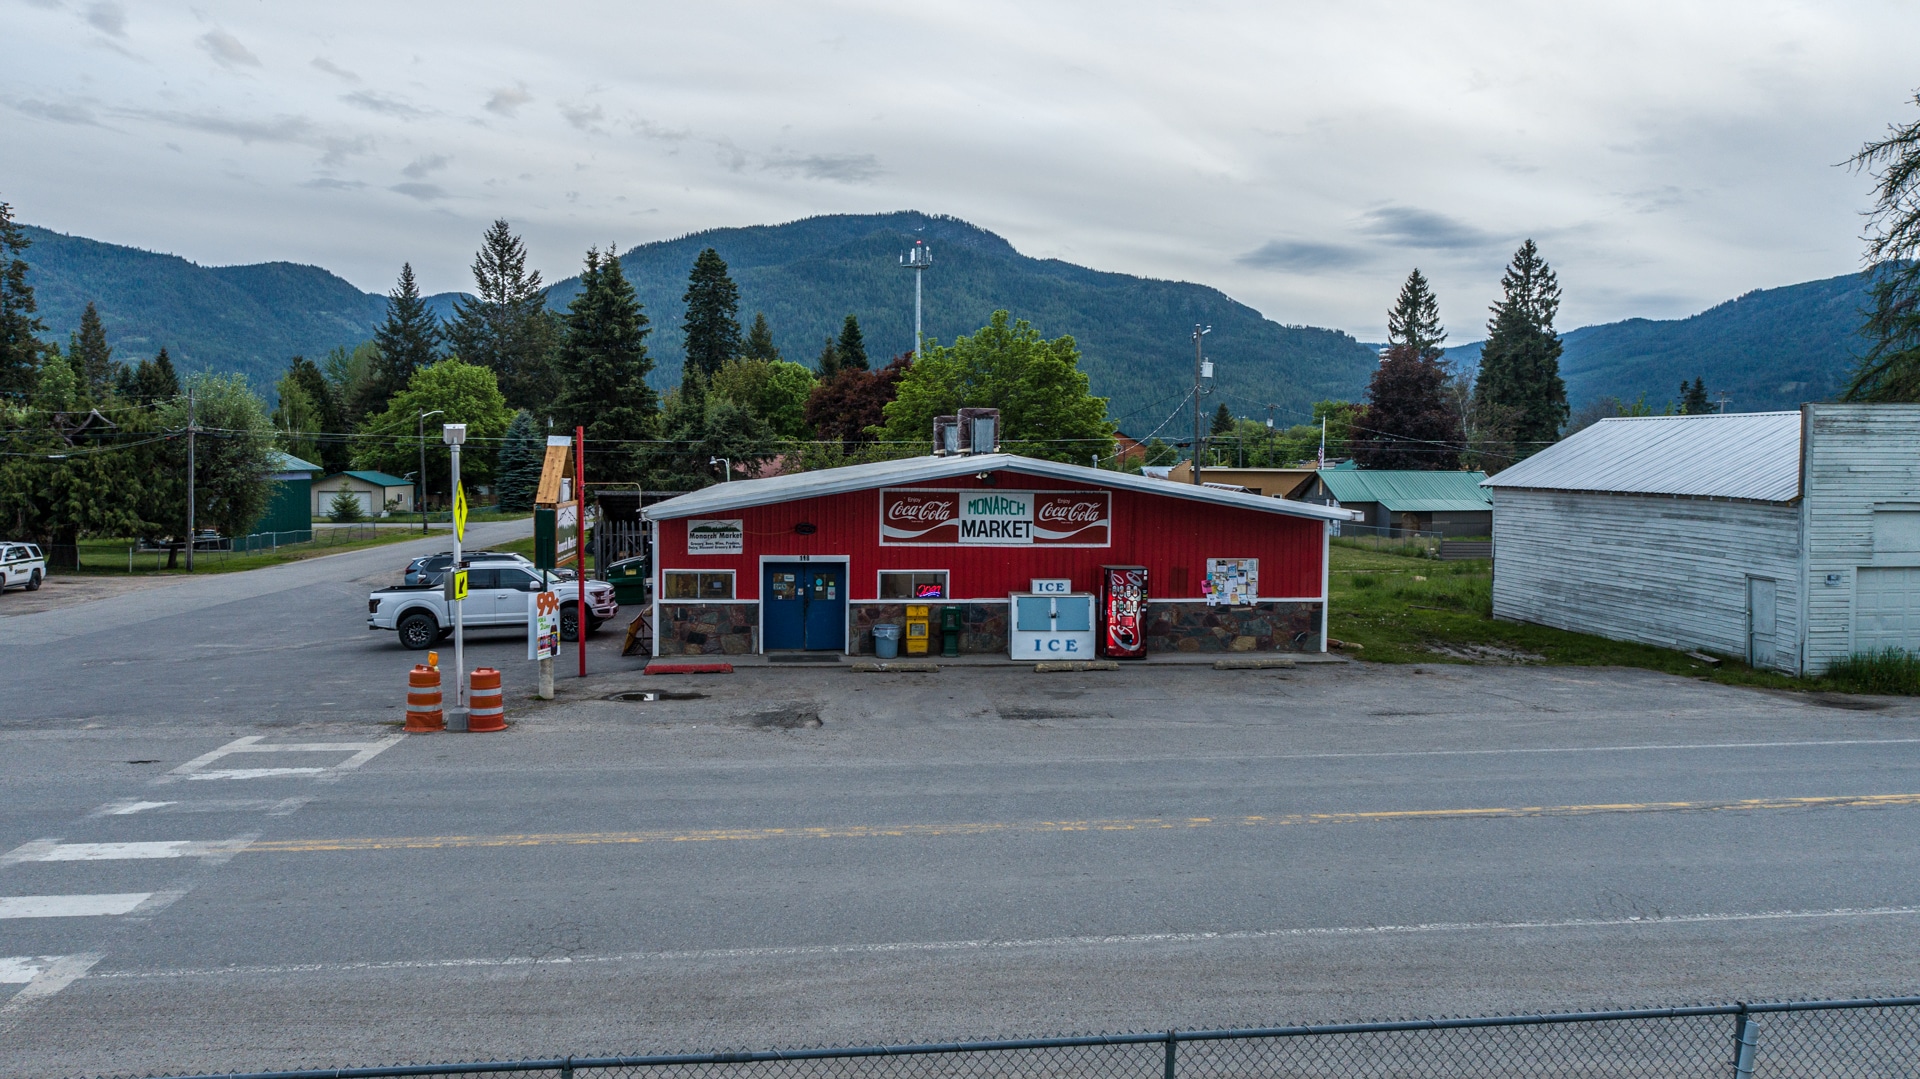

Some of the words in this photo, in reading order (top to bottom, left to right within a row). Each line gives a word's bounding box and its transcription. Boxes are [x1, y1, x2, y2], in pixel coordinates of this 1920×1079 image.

[907, 496, 921, 504] Enjoy
[968, 496, 1025, 515] MONARCH
[888, 500, 954, 521] Coca-Cola
[1038, 501, 1102, 522] Coca-Cola
[962, 520, 1032, 538] MARKET
[1038, 582, 1065, 592] ICE
[1034, 639, 1079, 652] ICE
